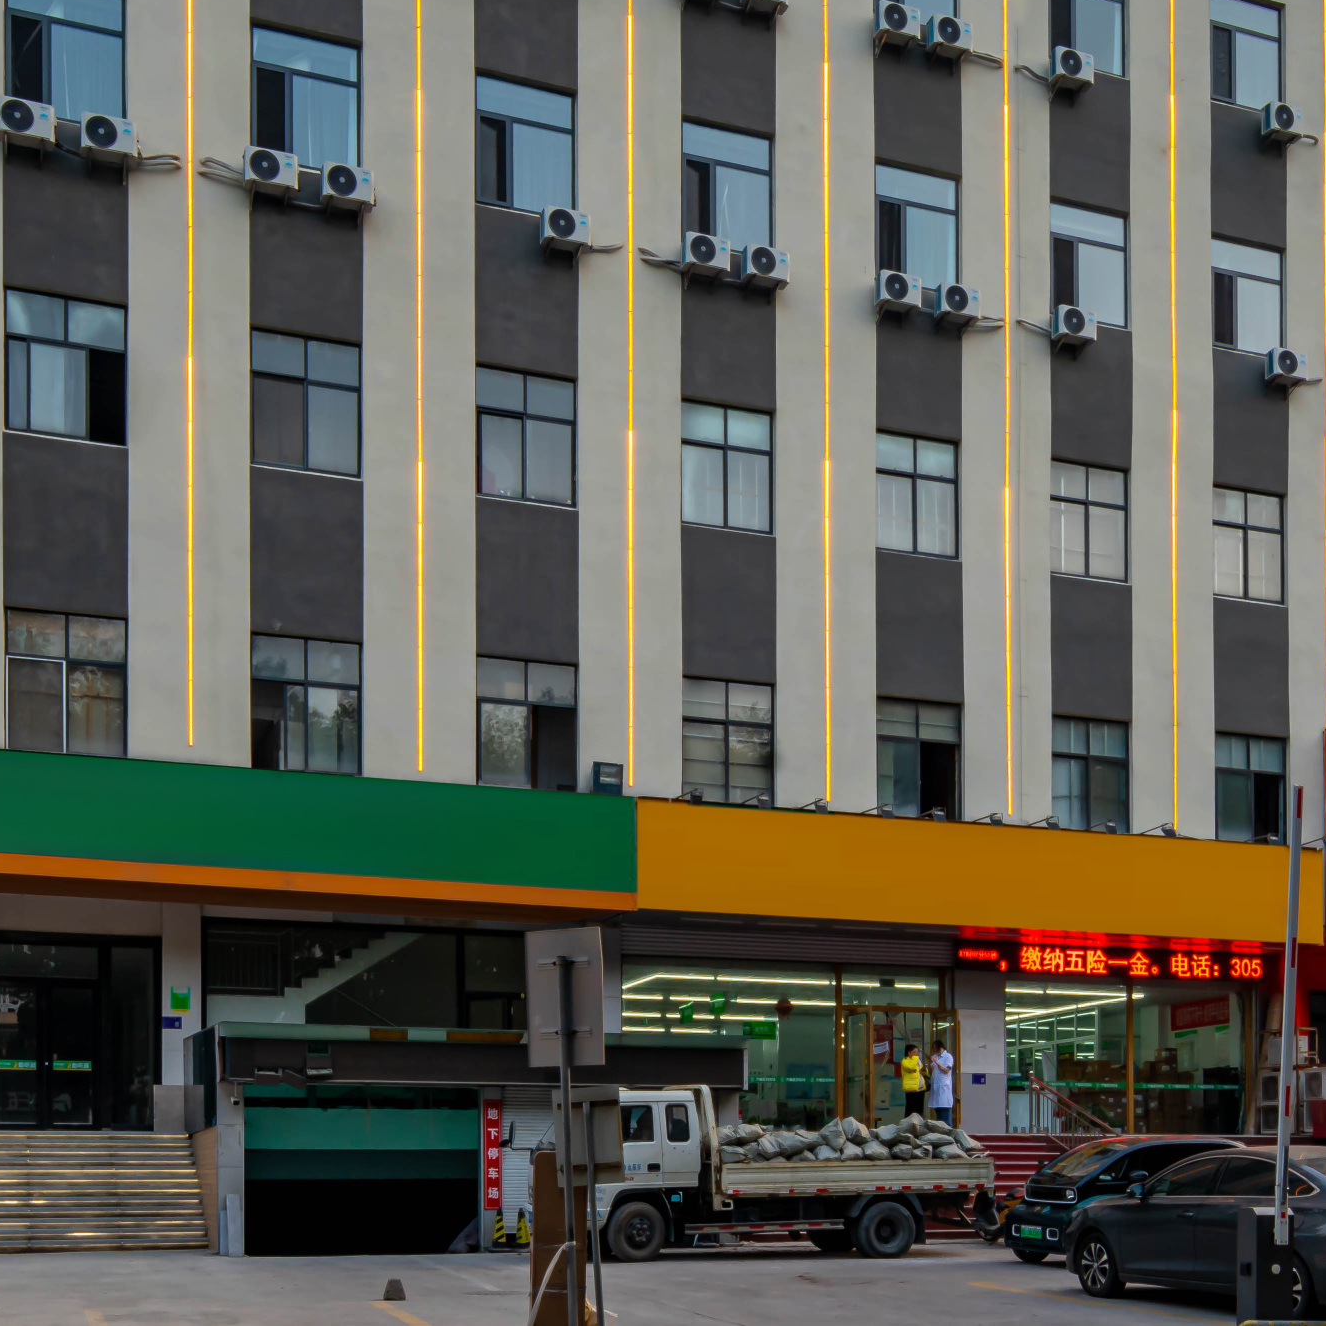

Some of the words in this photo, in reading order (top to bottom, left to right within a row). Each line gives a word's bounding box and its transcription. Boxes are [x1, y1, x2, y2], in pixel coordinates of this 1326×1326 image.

[487, 1108, 500, 1200] 地下停车场
